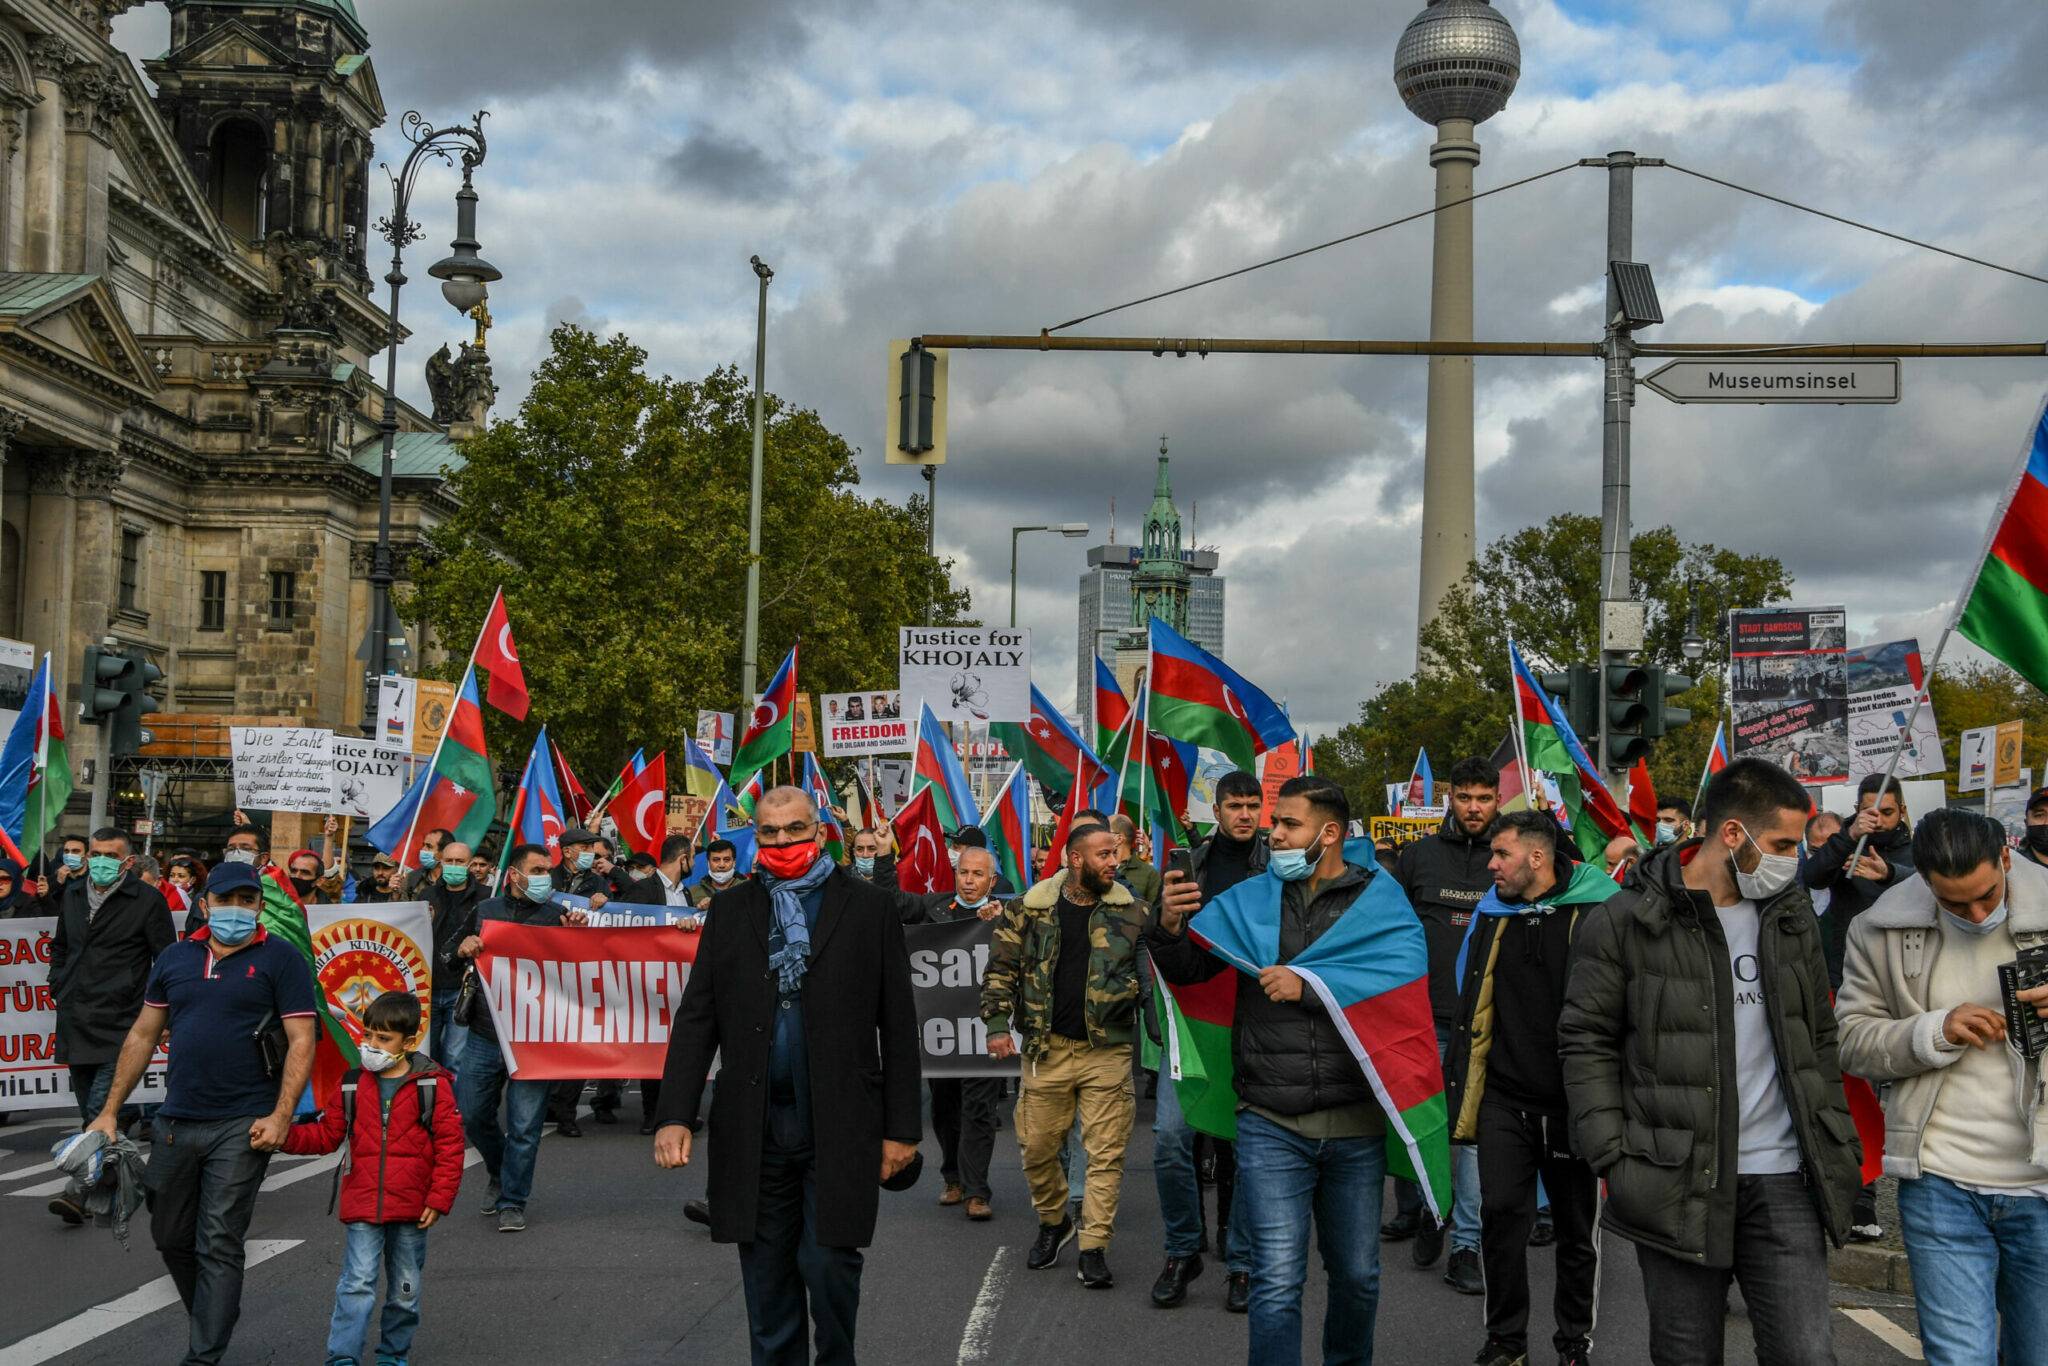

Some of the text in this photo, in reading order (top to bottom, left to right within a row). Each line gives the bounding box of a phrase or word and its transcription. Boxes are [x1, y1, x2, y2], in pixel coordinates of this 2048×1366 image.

[1708, 371, 1856, 389] Museumsinsel
[1739, 622, 1804, 634] STADT GANDSCHA
[904, 629, 1022, 649] Justice for
[903, 650, 1024, 670] KHOJALY
[1872, 697, 1912, 710] Karabach
[1873, 691, 1897, 703] jedes
[1769, 714, 1788, 726] das
[244, 729, 273, 746] Die
[832, 723, 907, 741] FREEDOM
[1749, 733, 1769, 745] von
[833, 742, 844, 750] FOR
[867, 739, 879, 747] AND
[1855, 735, 1890, 747] KARABACH
[373, 744, 399, 761] for
[239, 769, 248, 779] in
[332, 759, 399, 776] OJALY
[350, 939, 410, 977] KUVVETLER
[909, 943, 990, 988] sat
[491, 956, 692, 1044] ARMENIEN
